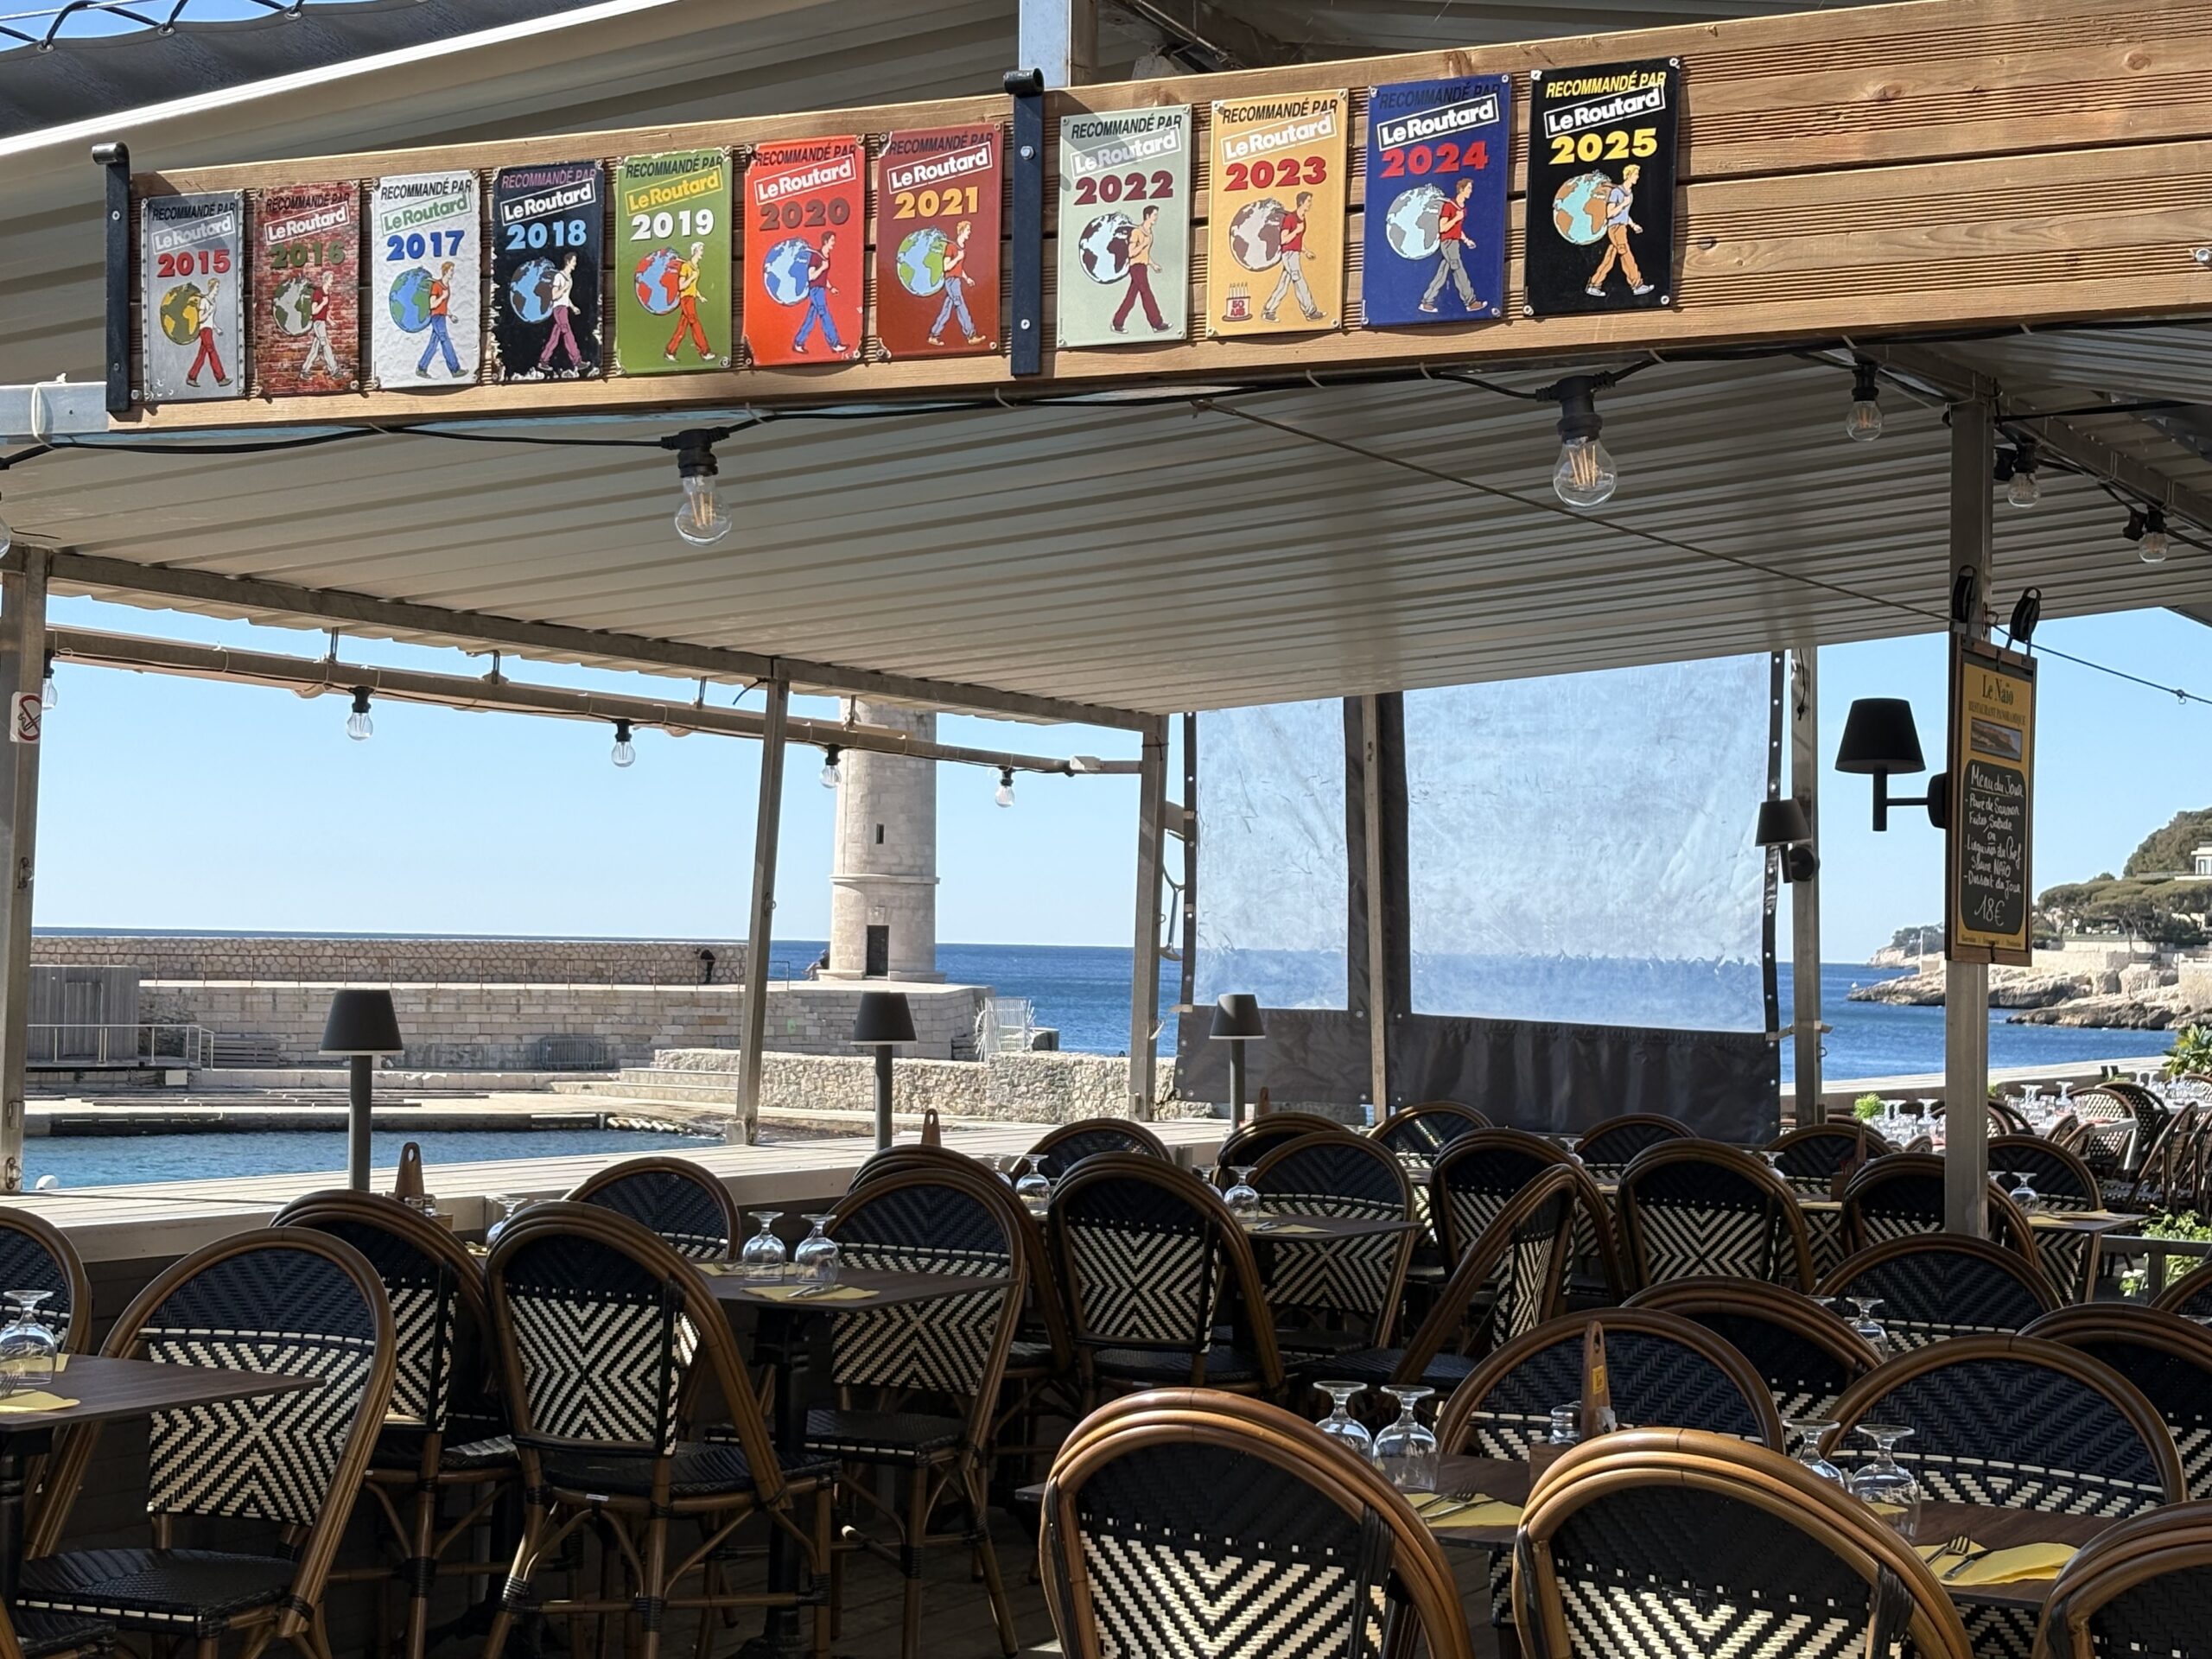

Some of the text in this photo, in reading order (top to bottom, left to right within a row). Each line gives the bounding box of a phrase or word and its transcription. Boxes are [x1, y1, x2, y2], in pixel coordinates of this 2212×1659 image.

[1380, 81, 1501, 110] RECOMMANDÉ PAR
[1546, 69, 1667, 99] RECOMMANDÉ PAR
[1223, 97, 1338, 124] RECOMMANDÉ PAR
[1071, 113, 1183, 140] RECOMMANDÉ PAR
[755, 143, 856, 167] RECOMMANDÉ PAR
[890, 131, 994, 156] RECOMMANDÉ PAR
[1548, 127, 1657, 165] 2025
[626, 155, 723, 179] RECOMMANDÉ PAR
[1224, 156, 1327, 192] 2023
[1380, 141, 1489, 179] 2024
[381, 177, 473, 200] RECOMMANDÉ PAR
[502, 168, 596, 189] RECOMMANDÉ PAR
[1074, 170, 1173, 206] 2022
[153, 202, 236, 221] RECOMMANDÉ PAR
[331, 193, 351, 207] PAR
[760, 198, 850, 231] 2020
[893, 187, 979, 219] 2021
[505, 219, 588, 251] 2018
[630, 209, 715, 241] 2019
[270, 240, 346, 270] 2016
[386, 230, 465, 262] 2017
[157, 249, 232, 277] 2015
[1982, 674, 1993, 701] Le
[1971, 764, 1993, 791] Menu
[1994, 774, 2005, 795] du
[1974, 893, 2005, 927] 18€
